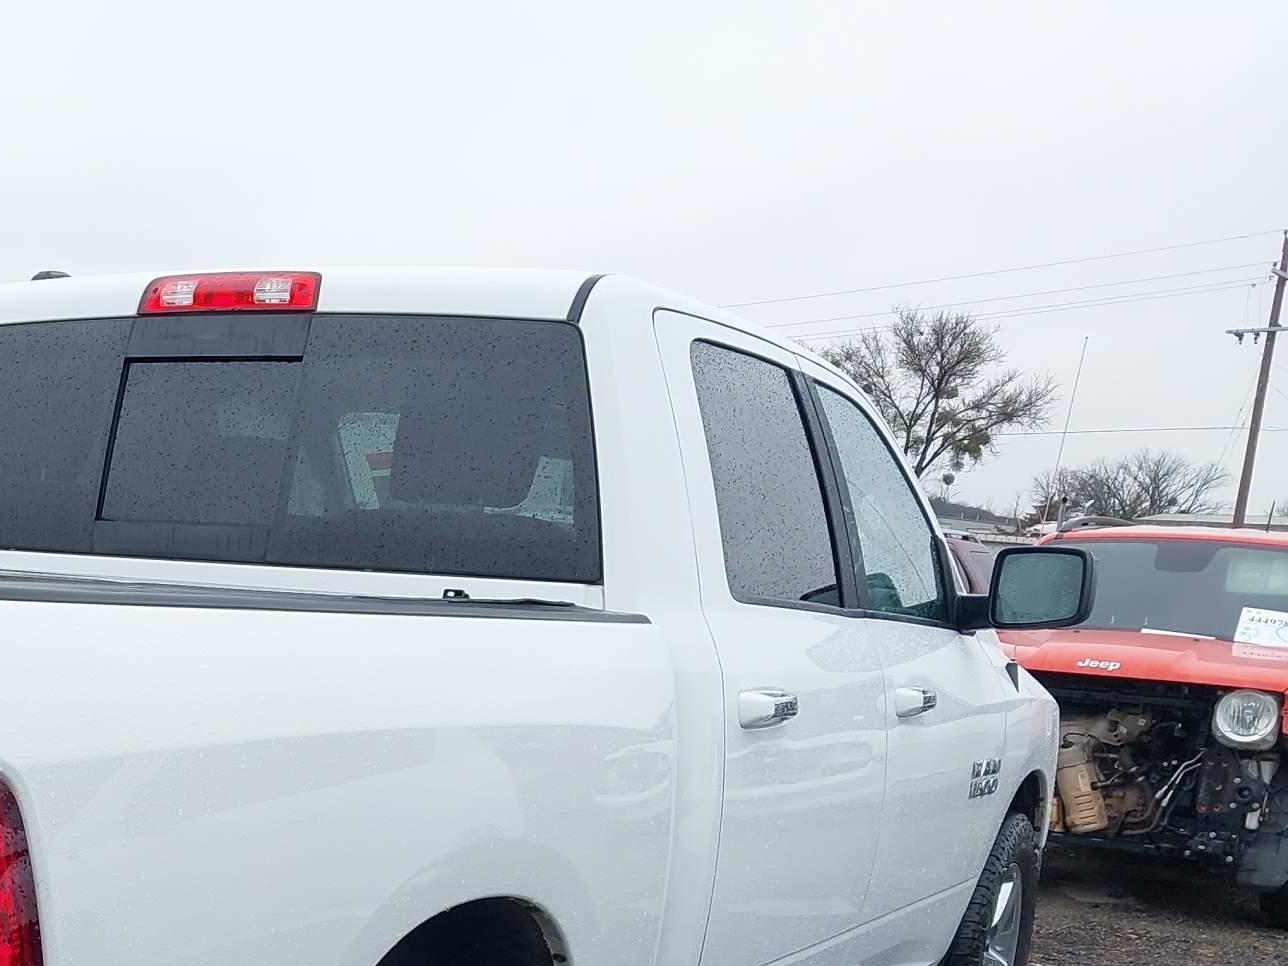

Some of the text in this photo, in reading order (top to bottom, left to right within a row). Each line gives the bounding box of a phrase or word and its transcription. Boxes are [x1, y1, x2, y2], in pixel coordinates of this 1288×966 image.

[1077, 658, 1121, 671] Jeep
[971, 758, 1001, 780] RAM
[968, 775, 999, 799] 1500
